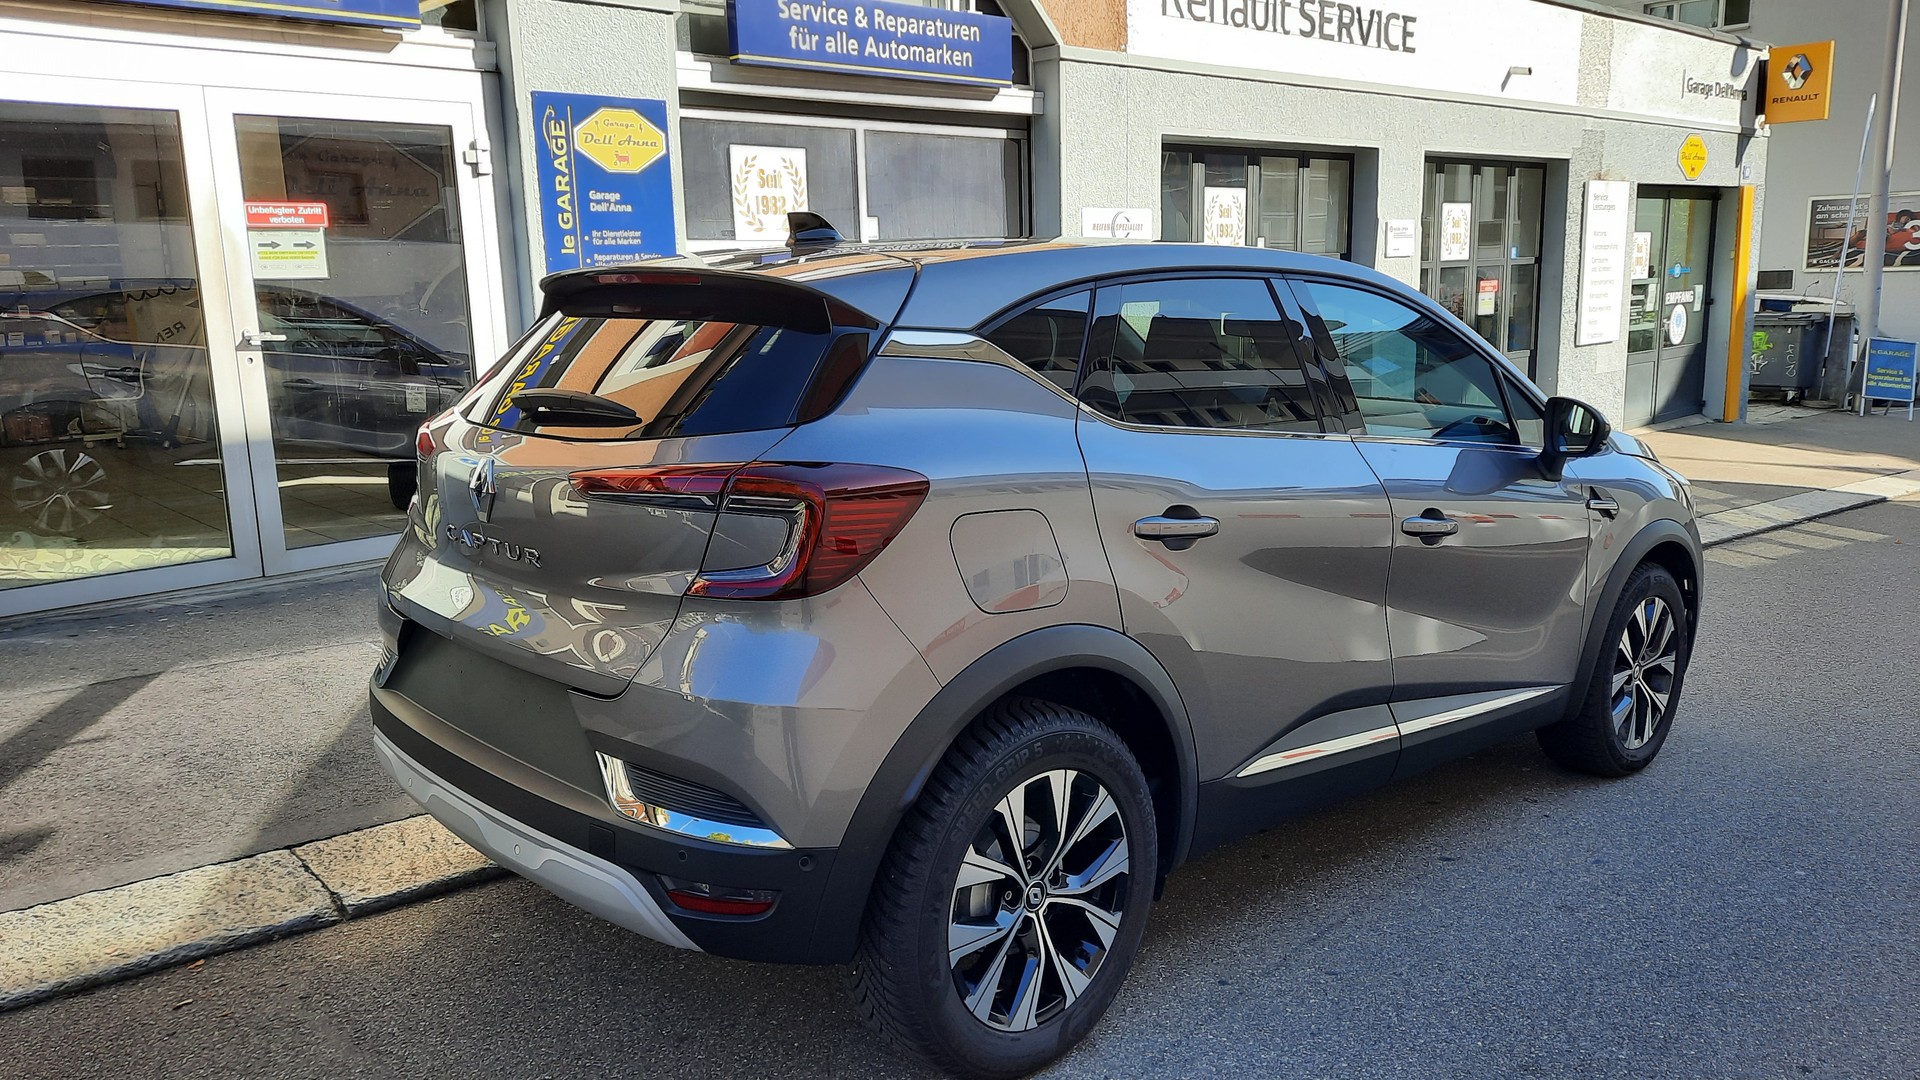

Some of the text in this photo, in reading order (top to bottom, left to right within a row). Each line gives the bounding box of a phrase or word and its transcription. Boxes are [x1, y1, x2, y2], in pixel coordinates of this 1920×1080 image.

[778, 0, 980, 42] Service & Reparaturen
[1298, 0, 1417, 53] SERVICE
[789, 26, 973, 67] für alle Automarken
[1686, 77, 1713, 99] Garage
[1772, 93, 1820, 104] RENAULT
[602, 119, 635, 129] Garage
[582, 132, 658, 147] Dell' Anna
[757, 168, 782, 188] Seit
[552, 119, 576, 254] le GARAGE
[589, 190, 620, 202] Garage
[248, 206, 322, 215] Unbefugten Zutritt
[590, 202, 632, 212] Dell'Anna
[755, 195, 787, 215] 1982
[1218, 204, 1232, 218] Seit
[1816, 204, 1850, 212] Zuhause
[594, 253, 634, 262] Reparaturen
[1666, 290, 1694, 304] EMPFANG
[1877, 349, 1910, 358] GARAGE
[446, 524, 543, 568] CAPTUR
